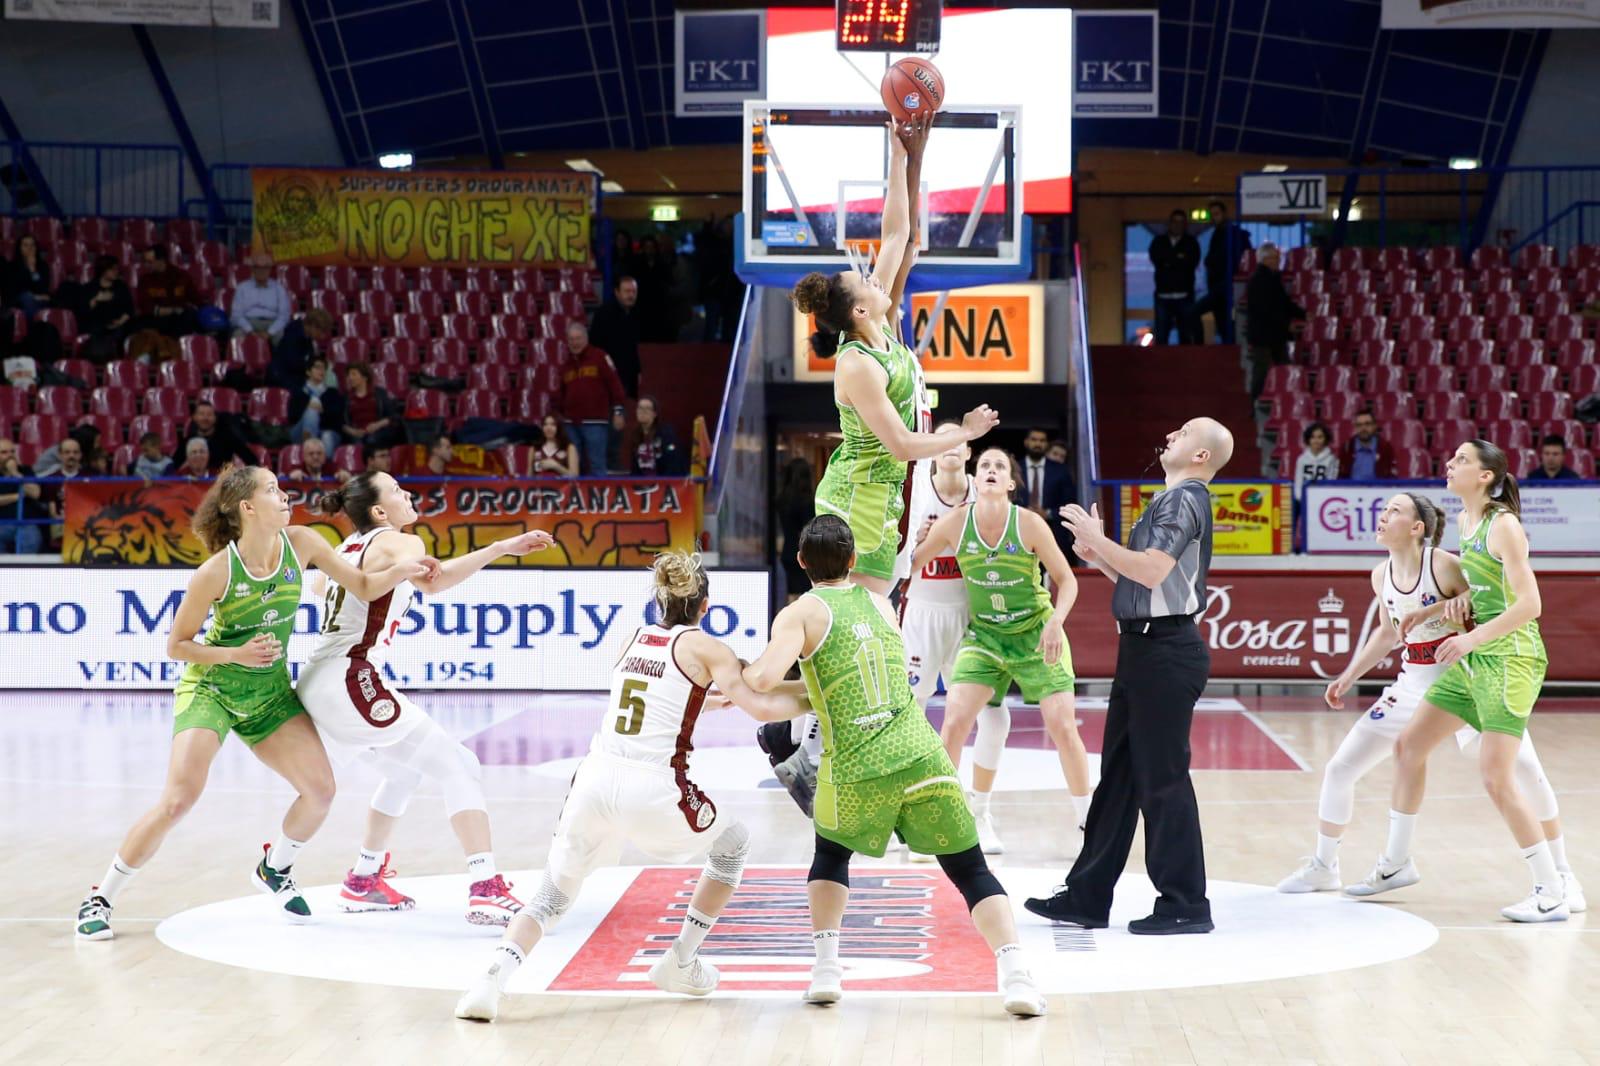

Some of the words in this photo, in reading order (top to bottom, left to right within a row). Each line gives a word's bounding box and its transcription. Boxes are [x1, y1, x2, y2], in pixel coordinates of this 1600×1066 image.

[841, 0, 908, 43] 24
[915, 42, 940, 52] PMF
[688, 60, 757, 81] FKT
[913, 66, 940, 104] Wilson
[1080, 61, 1150, 82] FKT
[339, 176, 460, 194] SUPPORTERS
[466, 177, 588, 194] OROGRANATA
[1279, 178, 1322, 209] VII
[344, 198, 414, 262] NO
[421, 199, 514, 263] GHE
[522, 198, 589, 263] XE
[913, 307, 1013, 358] ANA
[456, 484, 683, 516] OROGRANATA
[1318, 497, 1388, 541] Gif
[924, 559, 963, 577] UMA
[396, 589, 624, 650] Supply
[1195, 585, 1307, 650] Rosa
[423, 661, 494, 682] 1954
[853, 638, 891, 709] 17
[1243, 653, 1300, 666] venezia
[615, 679, 648, 735] 5
